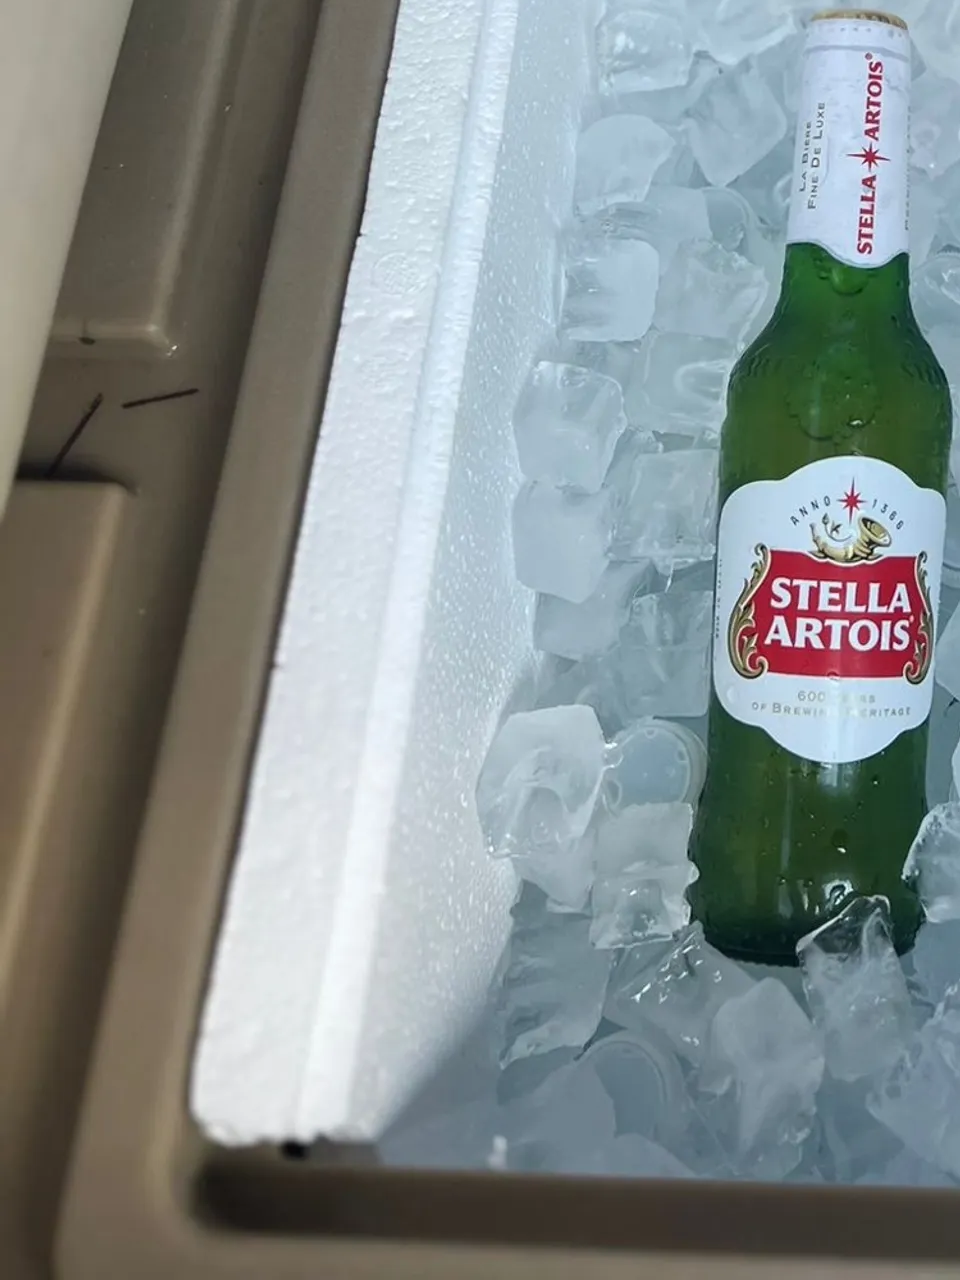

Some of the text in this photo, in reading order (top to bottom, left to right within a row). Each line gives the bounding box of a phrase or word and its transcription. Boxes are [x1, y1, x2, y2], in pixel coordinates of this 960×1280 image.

[857, 61, 884, 255] STELLA ARTOIS
[790, 496, 831, 526] ANNO
[770, 577, 912, 613] STELLA
[764, 615, 910, 651] ARTOIS
[797, 690, 826, 702] 600
